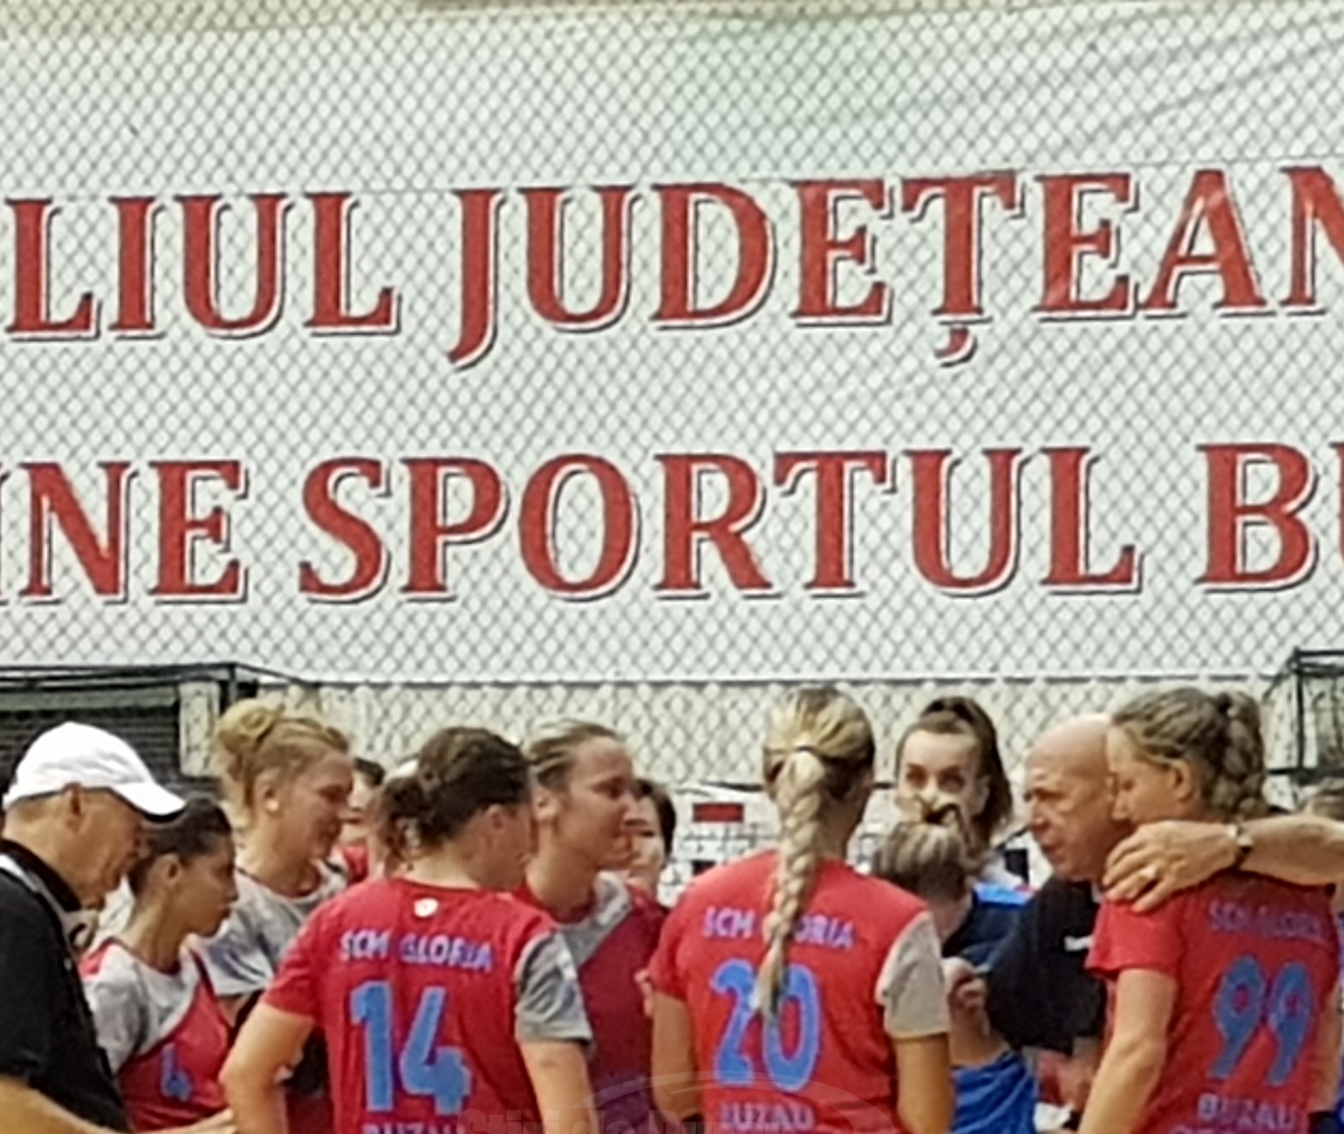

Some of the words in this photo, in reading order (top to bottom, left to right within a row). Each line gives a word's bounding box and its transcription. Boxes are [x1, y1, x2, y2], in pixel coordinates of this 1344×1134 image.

[299, 447, 1142, 603] SPORTUL
[349, 980, 473, 1116] 14
[711, 958, 822, 1093] 20
[1208, 955, 1316, 1088] 99
